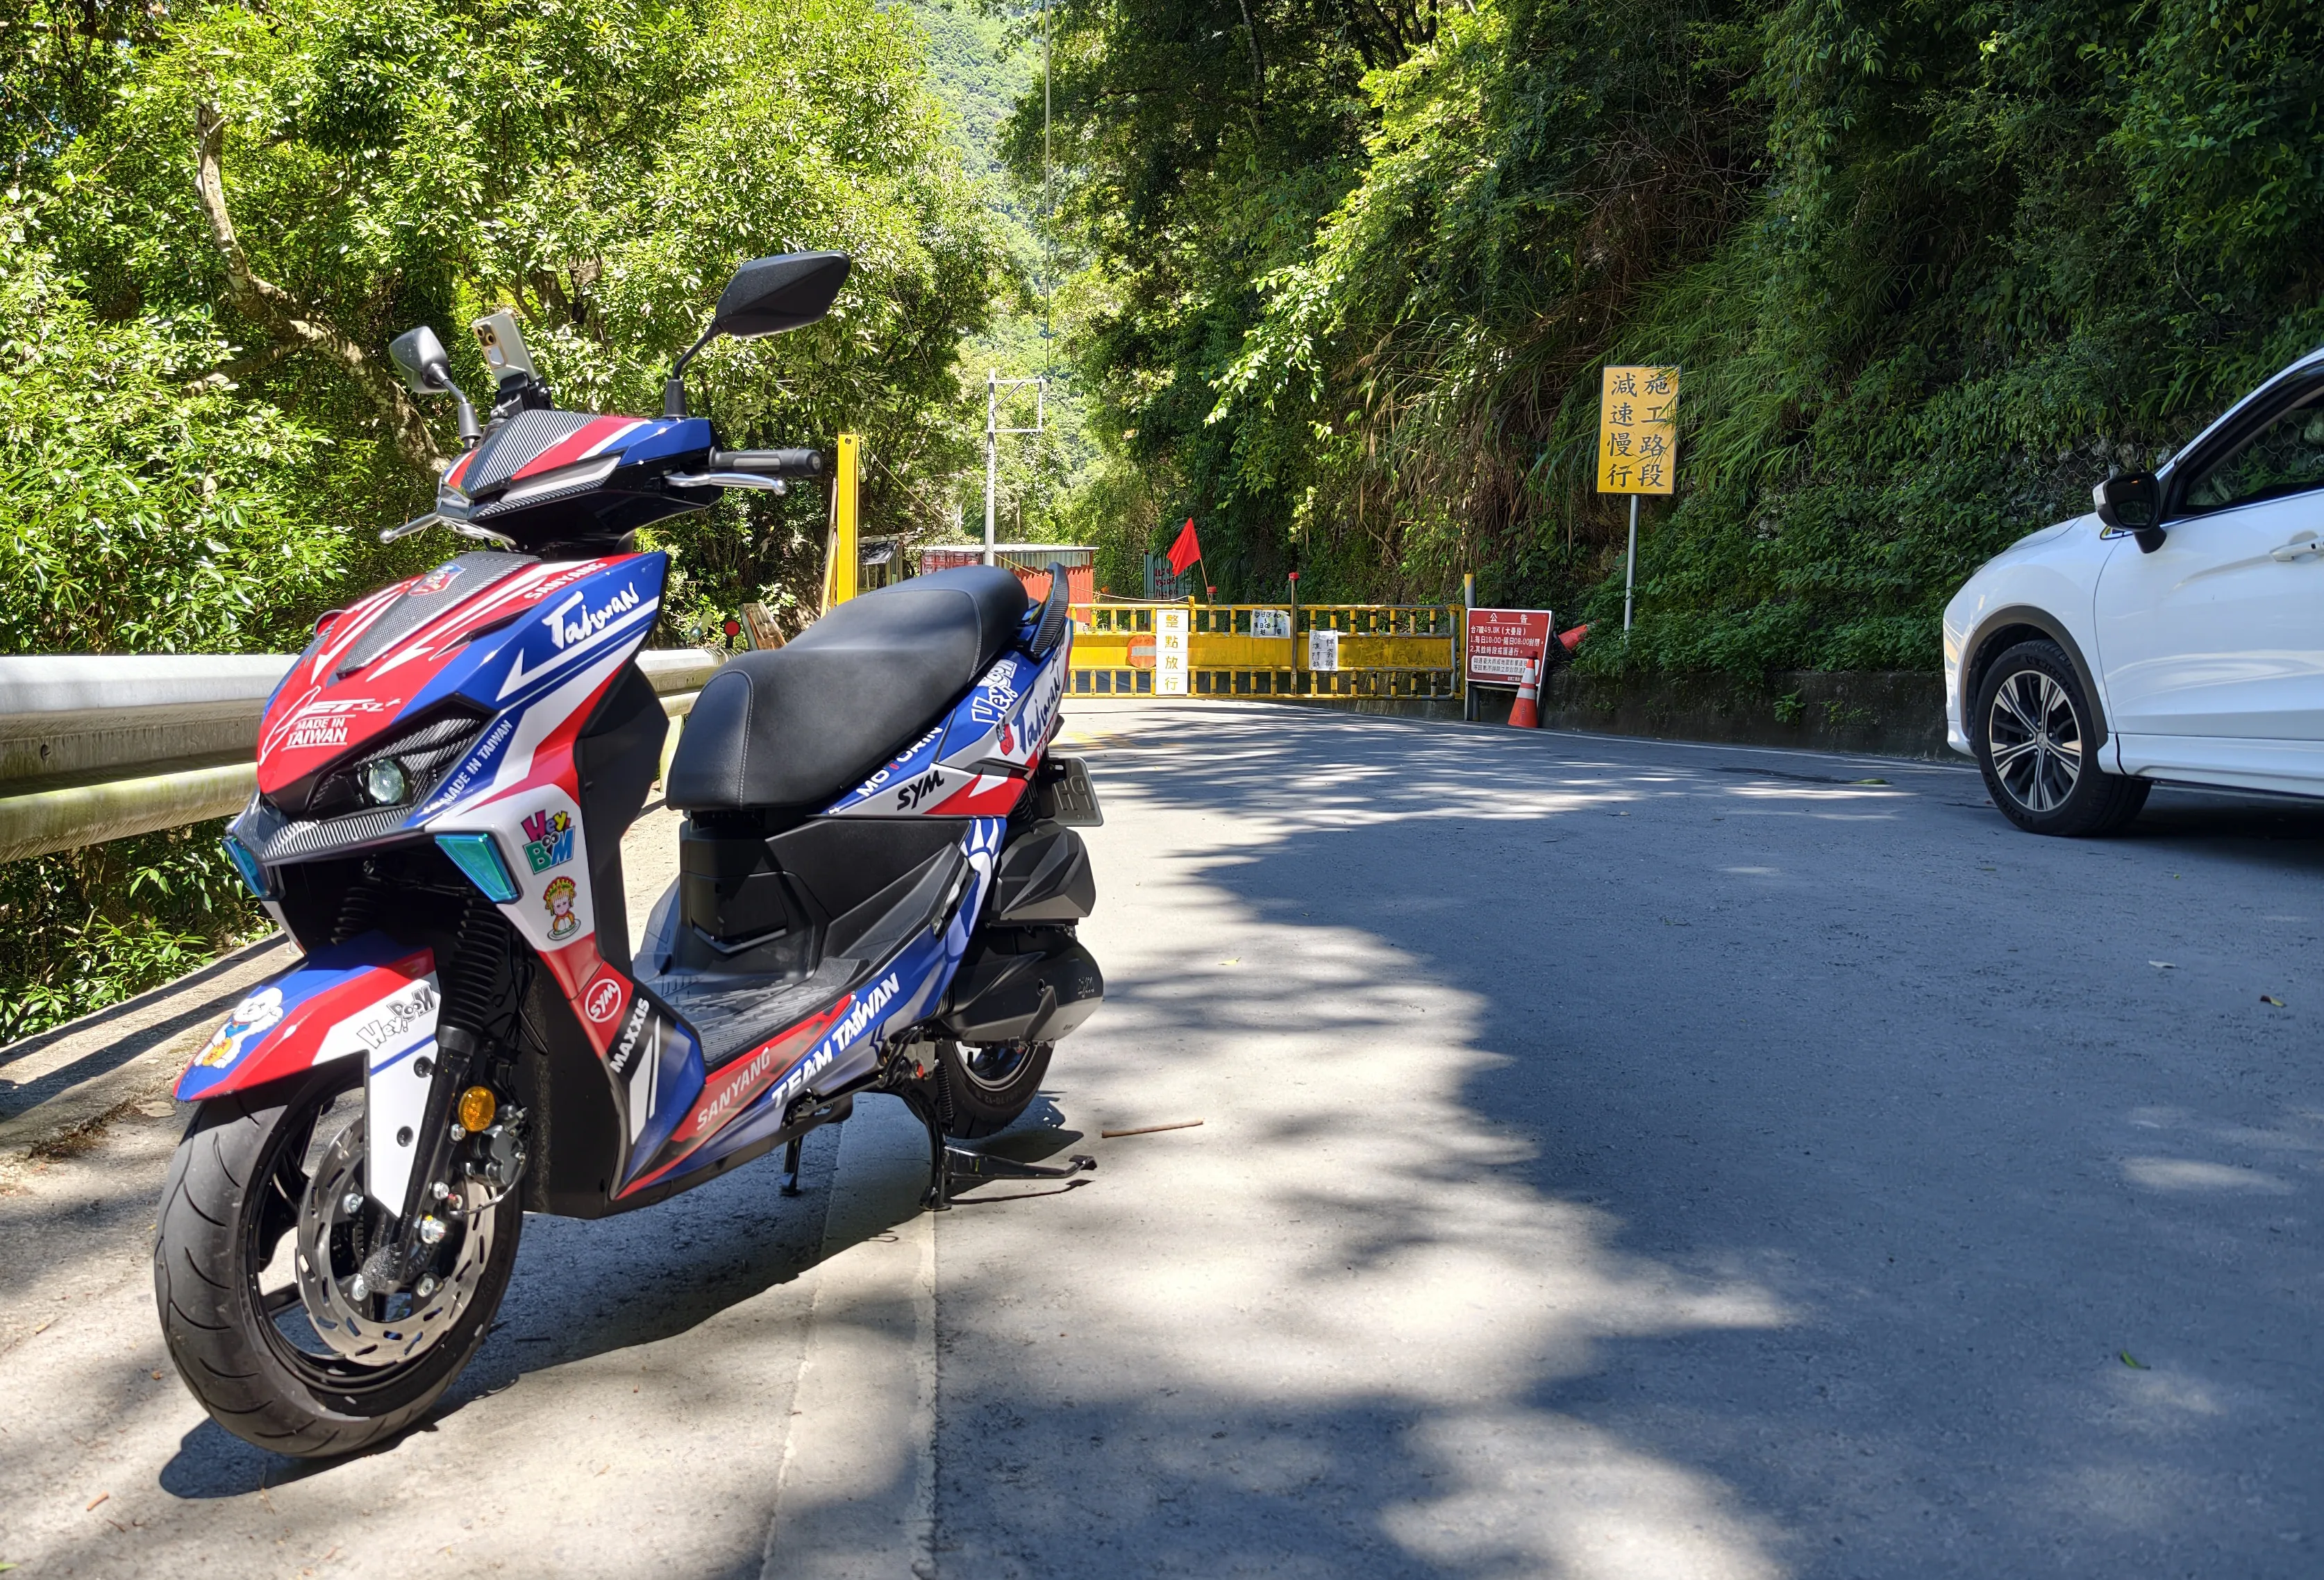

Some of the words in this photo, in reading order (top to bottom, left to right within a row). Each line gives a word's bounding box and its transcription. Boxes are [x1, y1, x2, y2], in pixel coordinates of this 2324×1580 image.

[1605, 373, 1637, 487] 減速慢行
[1637, 374, 1670, 487] 施工路段
[524, 561, 608, 600] SANYANG
[1165, 615, 1178, 691] 整點放行
[286, 727, 348, 746] TAIWAN
[296, 717, 328, 730] MADE
[331, 717, 345, 728] IN
[440, 771, 471, 805] MADE
[466, 757, 483, 775] IN
[477, 719, 513, 760] TAIWAN
[897, 770, 945, 812] SYM
[590, 983, 619, 1018] SYM
[610, 998, 650, 1073] MAXXIS
[771, 1041, 833, 1108] TEAM
[832, 973, 900, 1052] TAIWAN
[697, 1047, 771, 1131] SANYANG
